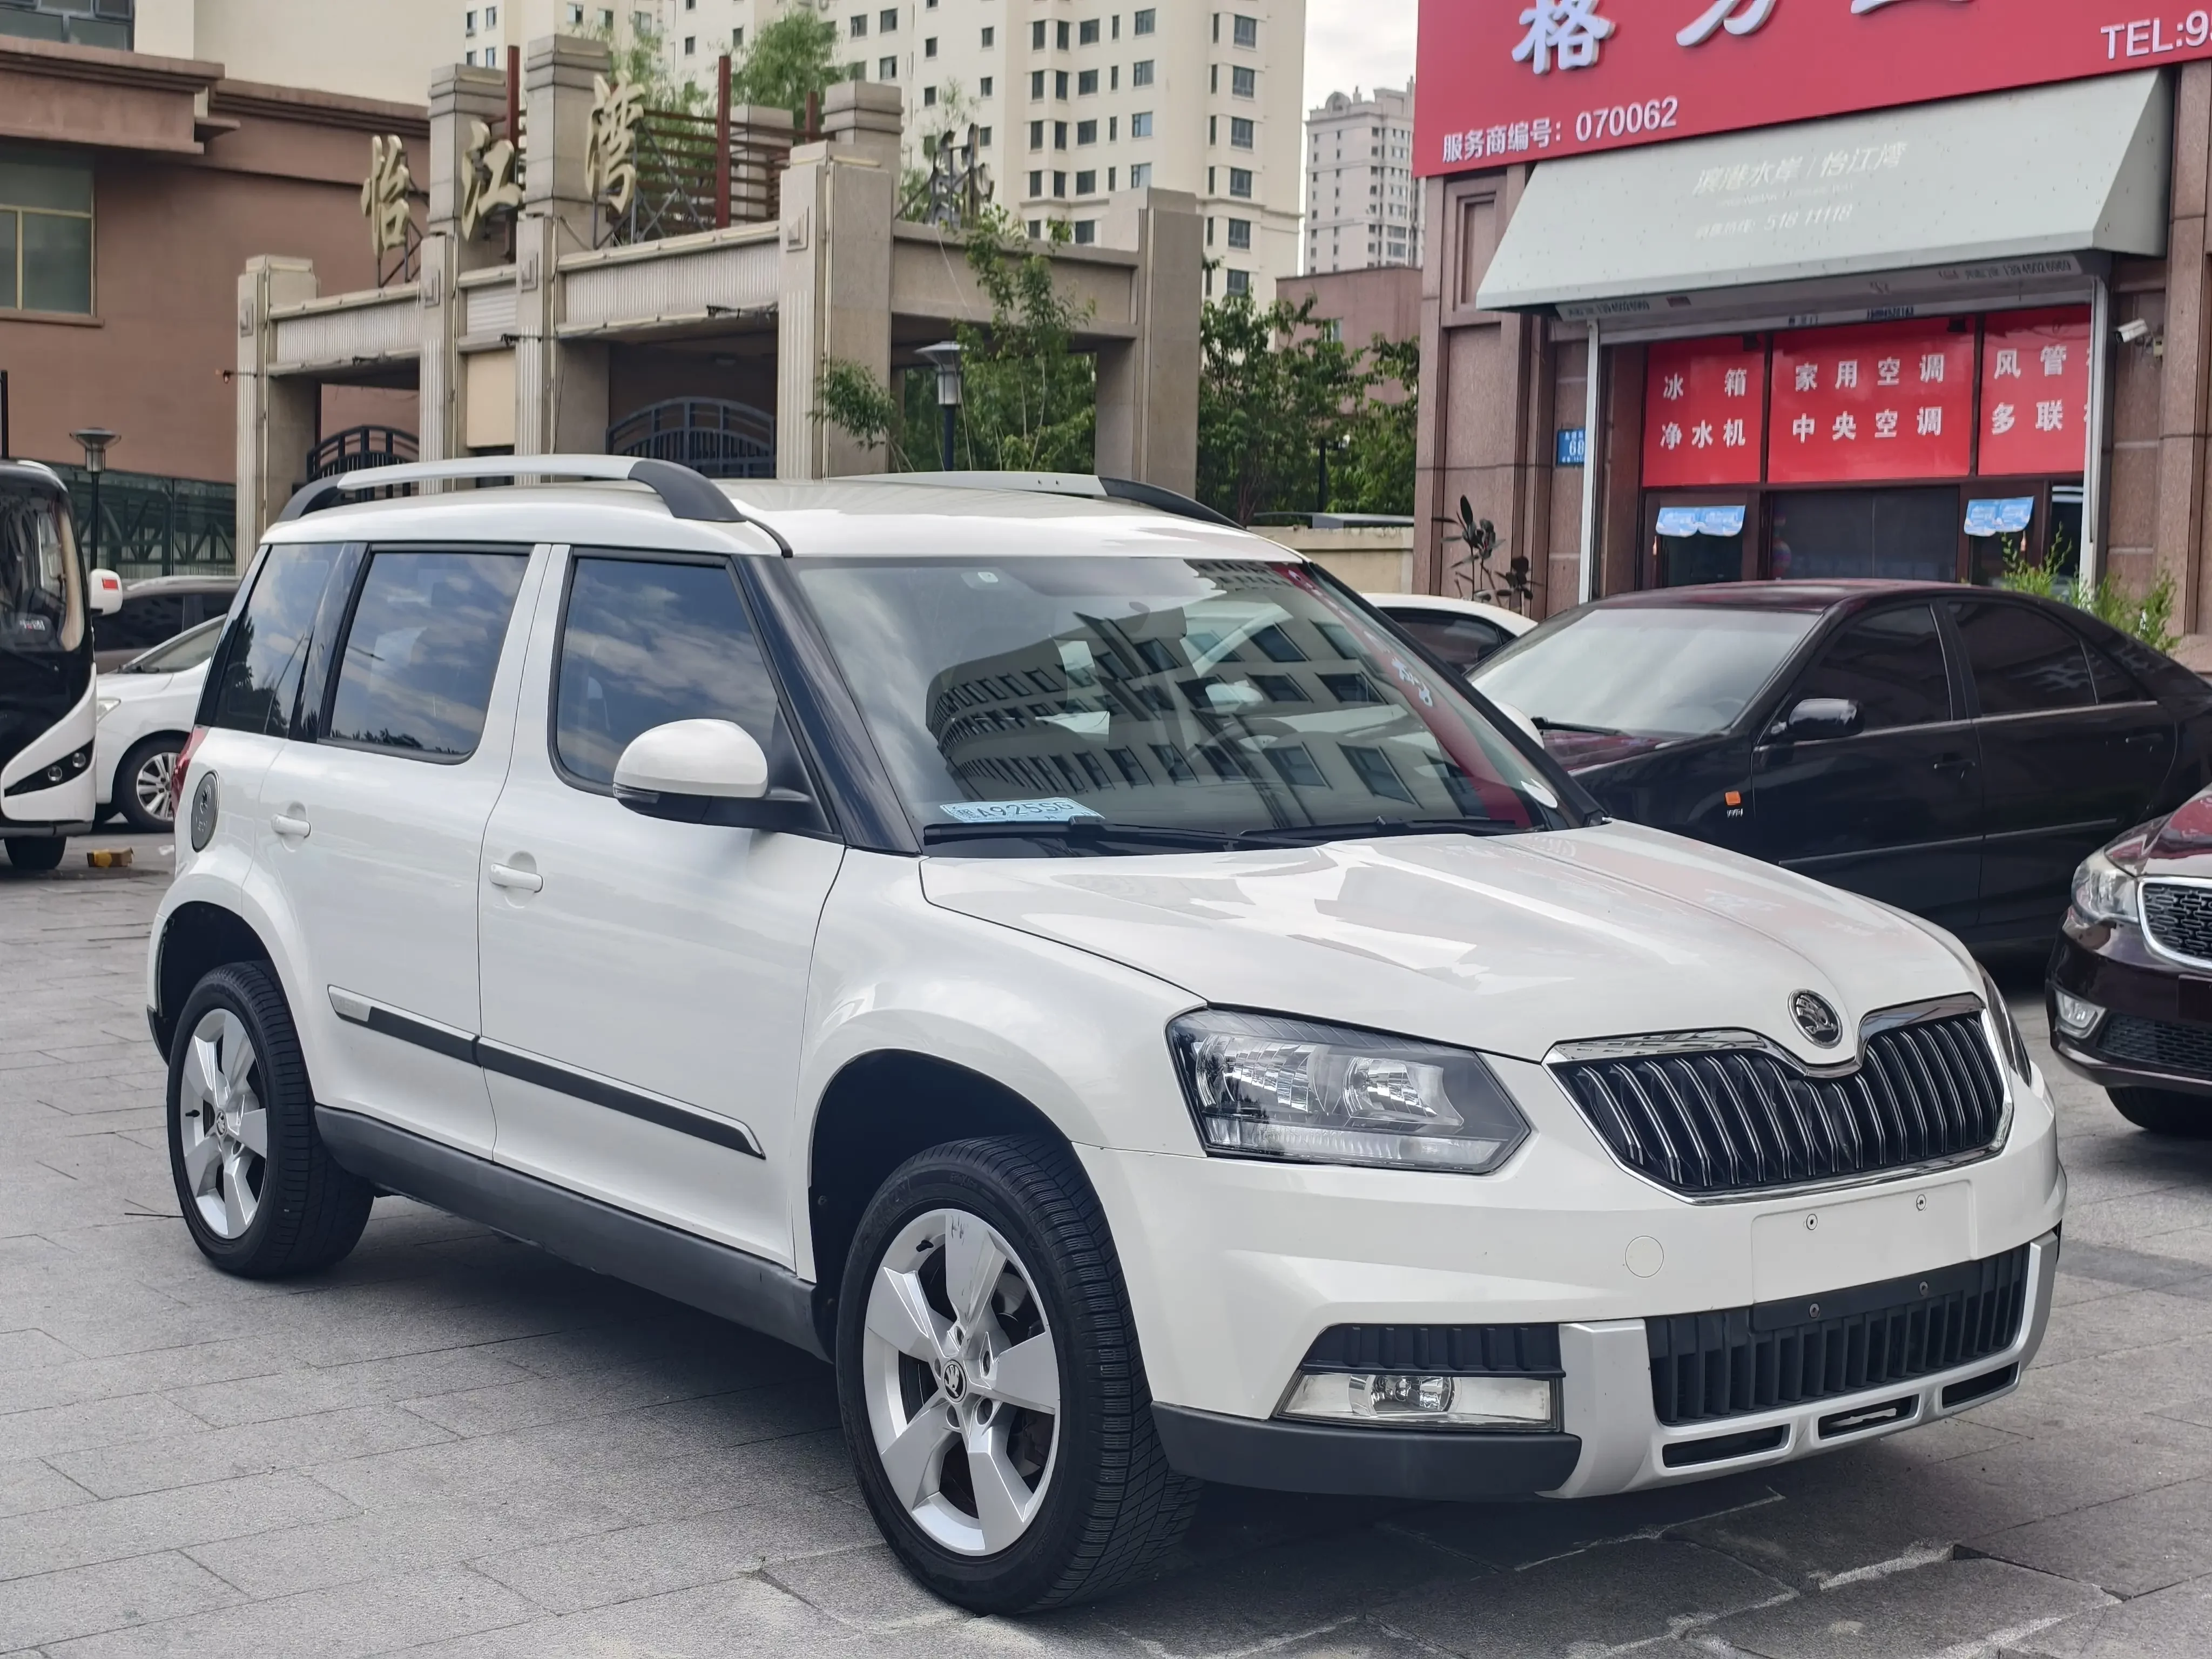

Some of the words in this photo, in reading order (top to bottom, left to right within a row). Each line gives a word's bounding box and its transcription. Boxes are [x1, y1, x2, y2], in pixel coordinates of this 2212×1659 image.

[2100, 10, 2212, 59] TEL:9
[1575, 96, 1678, 141] 070062
[360, 69, 645, 259] 怡江湾
[1795, 353, 1944, 392] 家用空调
[1994, 343, 2090, 380] 风管
[1663, 367, 1747, 401] 冰箱
[1660, 418, 1746, 449] 净水机
[1792, 406, 1943, 444] 中央空调
[1992, 399, 2088, 435] 多联
